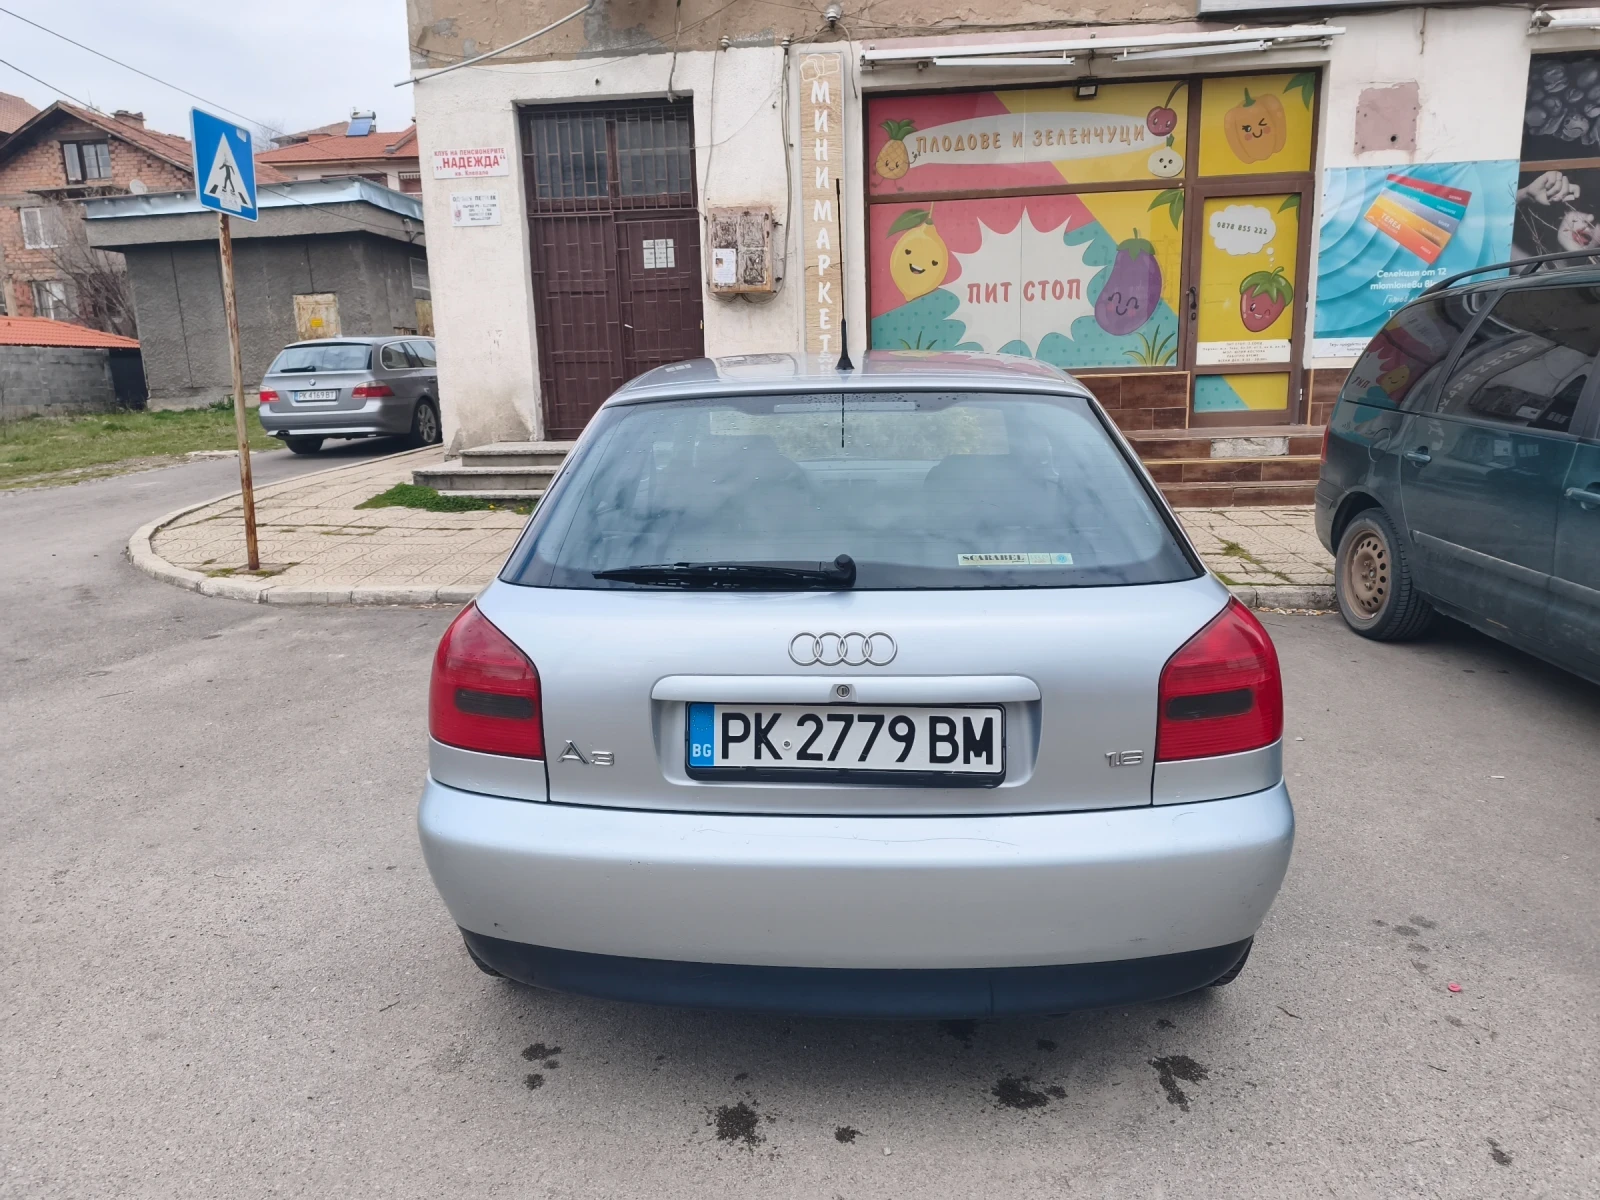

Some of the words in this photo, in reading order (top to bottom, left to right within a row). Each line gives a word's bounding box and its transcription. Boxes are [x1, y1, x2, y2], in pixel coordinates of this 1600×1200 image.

[810, 79, 831, 189] МИНИ
[915, 131, 1001, 153] ПЛОДОВЕ
[1012, 131, 1023, 148] И
[1032, 124, 1145, 146] ЗЕЛЕНЧУЦИ
[460, 148, 504, 156] ПЕНСИОНЕРИТЕ
[1217, 221, 1235, 230] 0878
[1238, 224, 1251, 232] 855
[1254, 226, 1268, 235] 222
[1381, 213, 1402, 230] TEREA
[813, 198, 833, 353] МАРКЕТ
[1376, 269, 1420, 279] Селекция
[1437, 267, 1447, 275] 12
[967, 282, 1012, 304] ПИТ
[1023, 279, 1081, 302] СТОП
[1370, 280, 1423, 290] тютюневи
[721, 712, 783, 760] PK
[796, 713, 916, 763] 2779
[928, 715, 994, 766] BM
[556, 740, 614, 766] A3
[692, 743, 711, 757] BG
